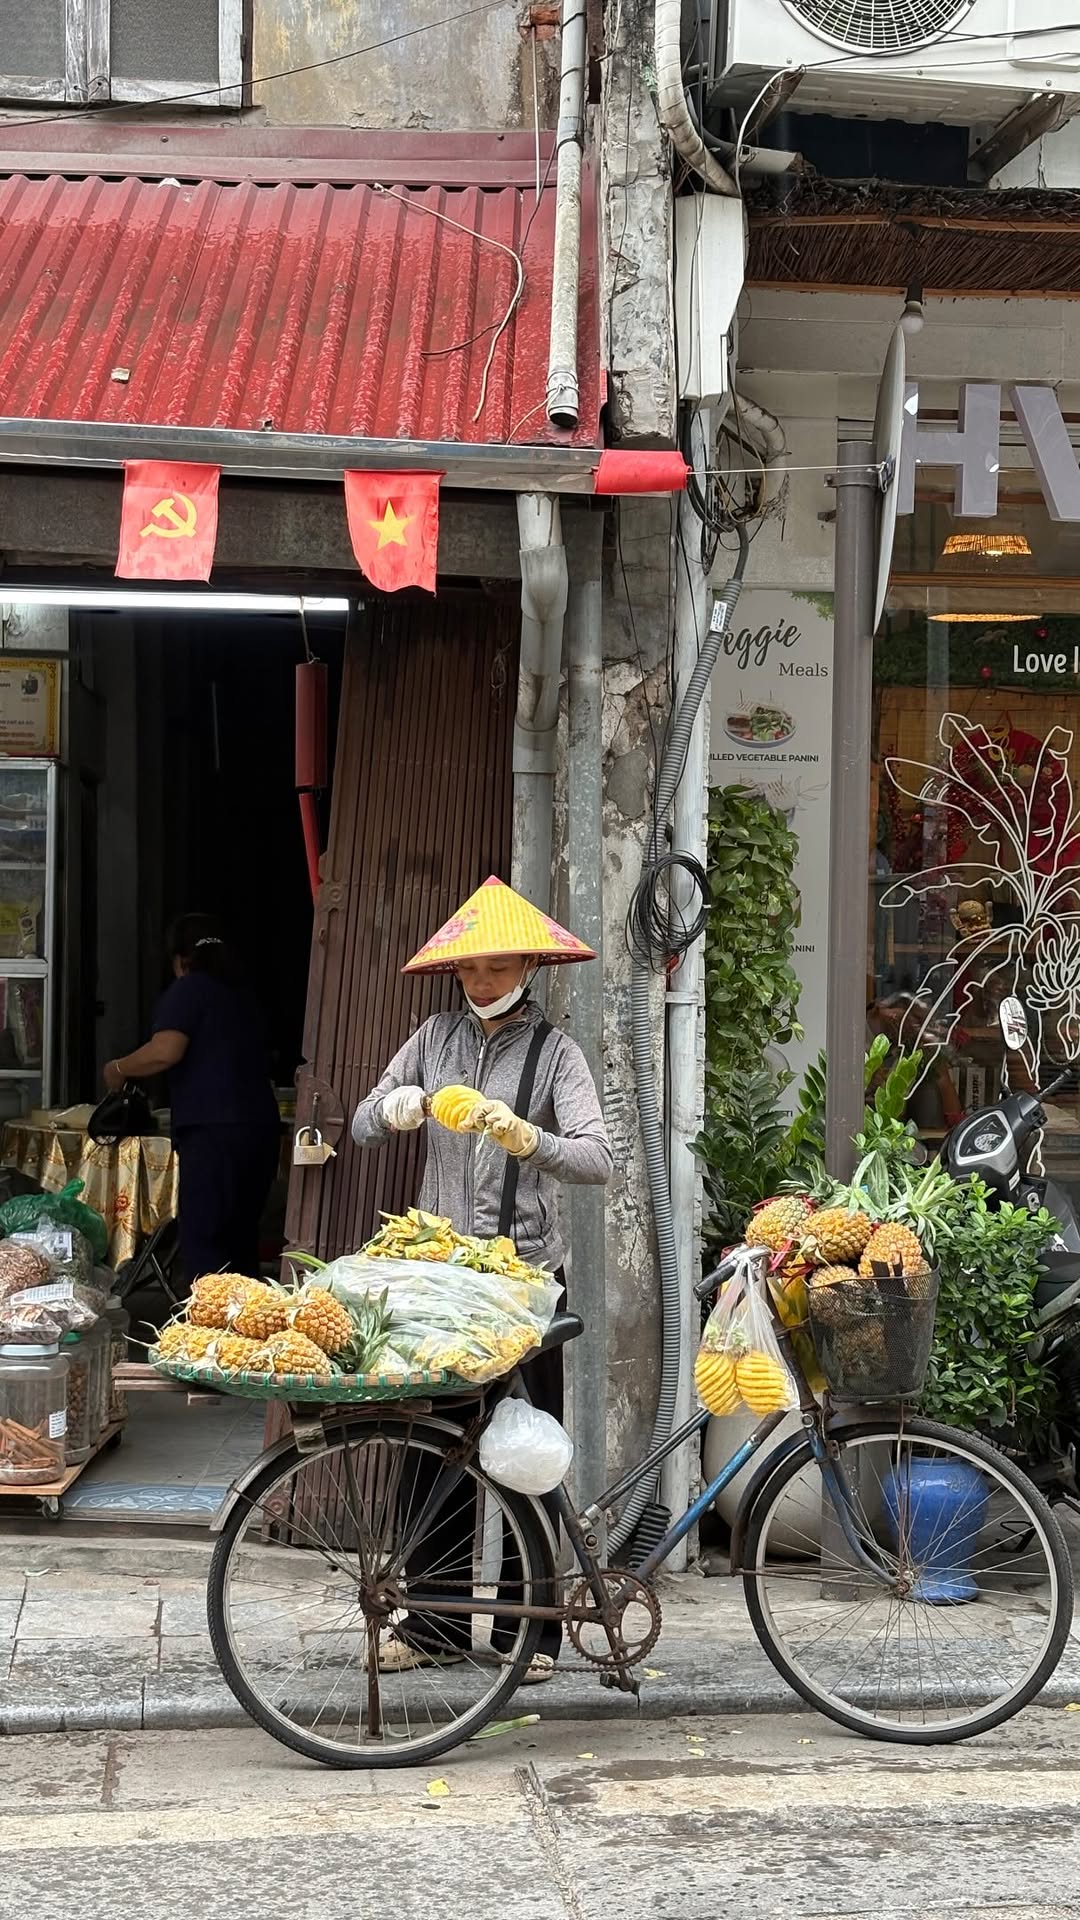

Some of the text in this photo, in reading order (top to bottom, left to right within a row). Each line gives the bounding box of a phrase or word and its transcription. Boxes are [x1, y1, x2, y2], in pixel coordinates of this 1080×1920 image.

[1013, 644, 1067, 674] Love
[779, 662, 828, 677] Meals
[736, 753, 787, 762] VEGETABLE
[788, 754, 819, 762] PANINI
